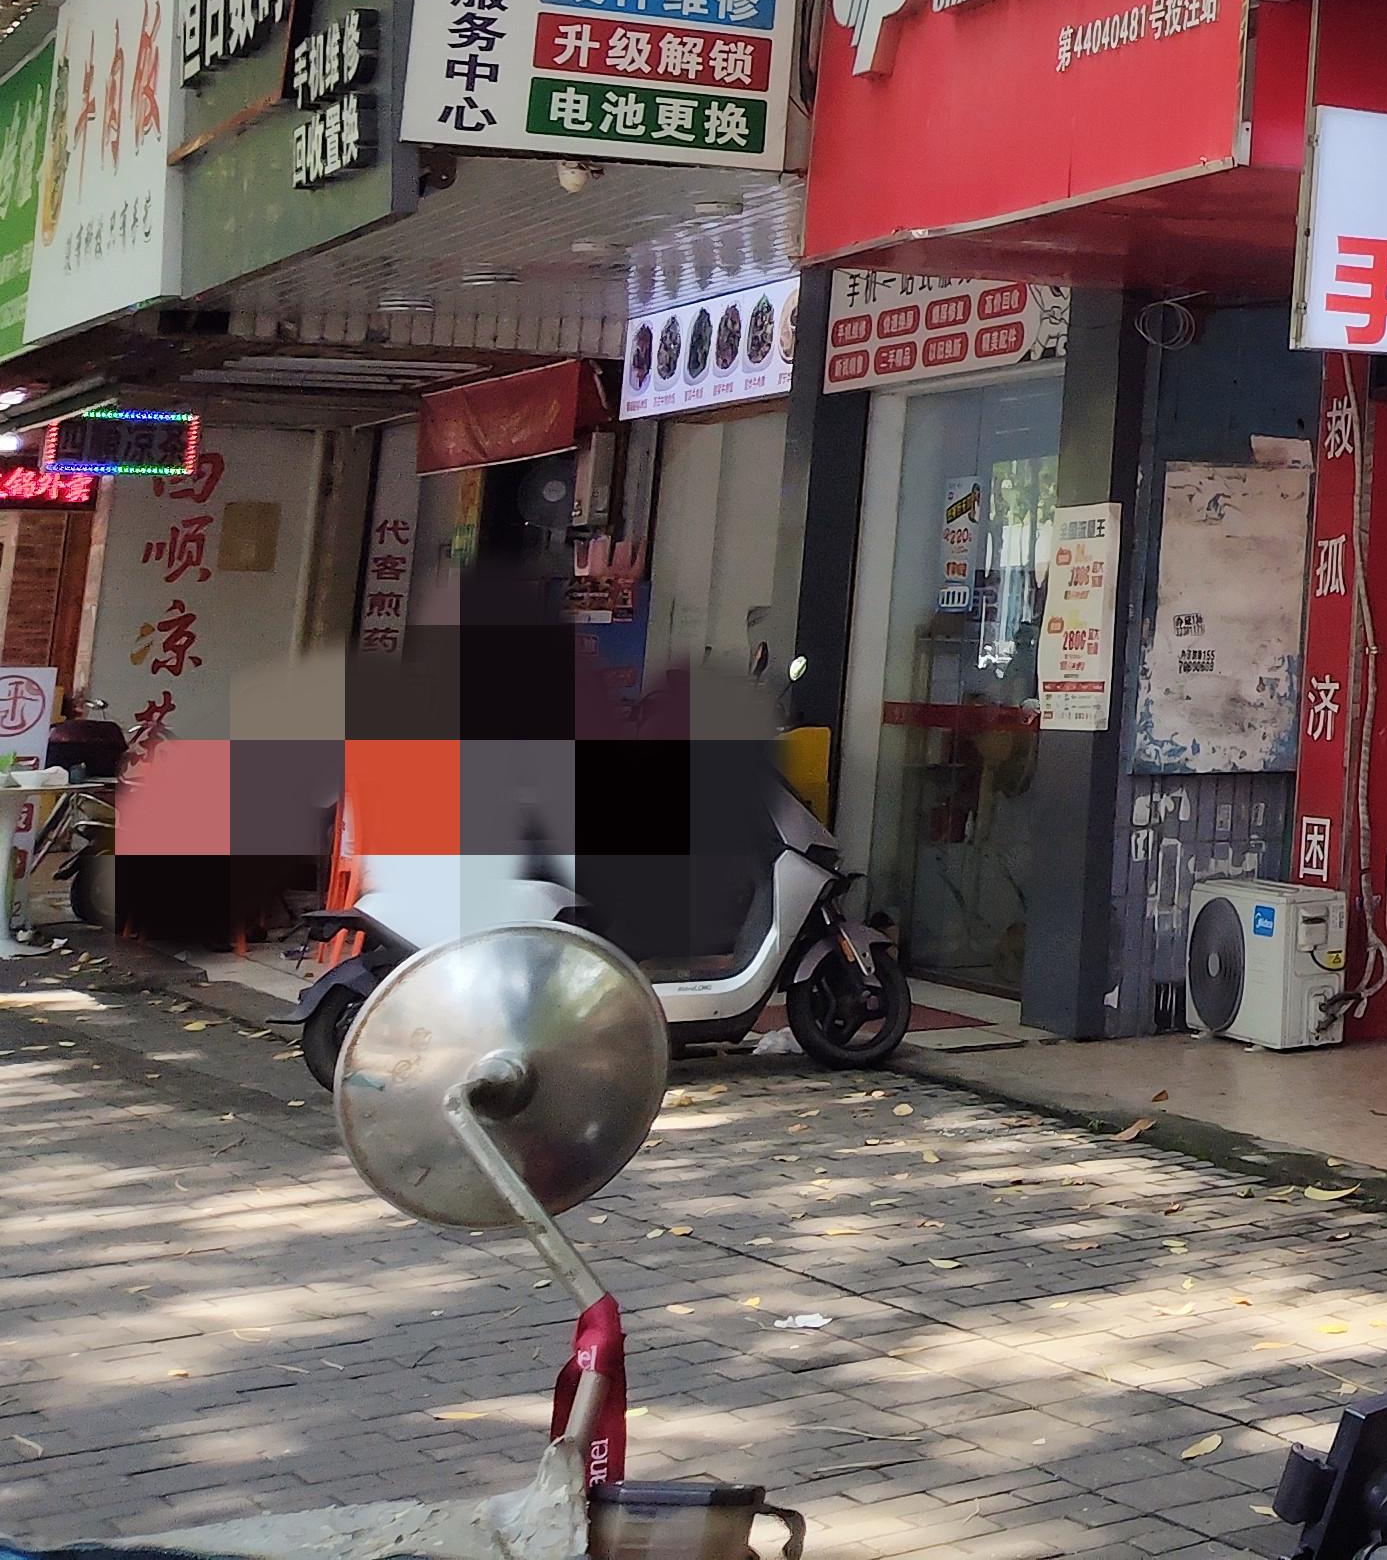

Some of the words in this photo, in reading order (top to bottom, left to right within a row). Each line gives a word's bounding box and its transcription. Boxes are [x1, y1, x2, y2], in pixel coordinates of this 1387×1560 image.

[293, 12, 362, 110] 手机维修
[554, 24, 754, 86] 升级解锁
[293, 96, 361, 189] 回收置换
[549, 87, 749, 146] 电池更换
[361, 519, 411, 656] 代客煎药
[1299, 397, 1356, 883] 救孤济困
